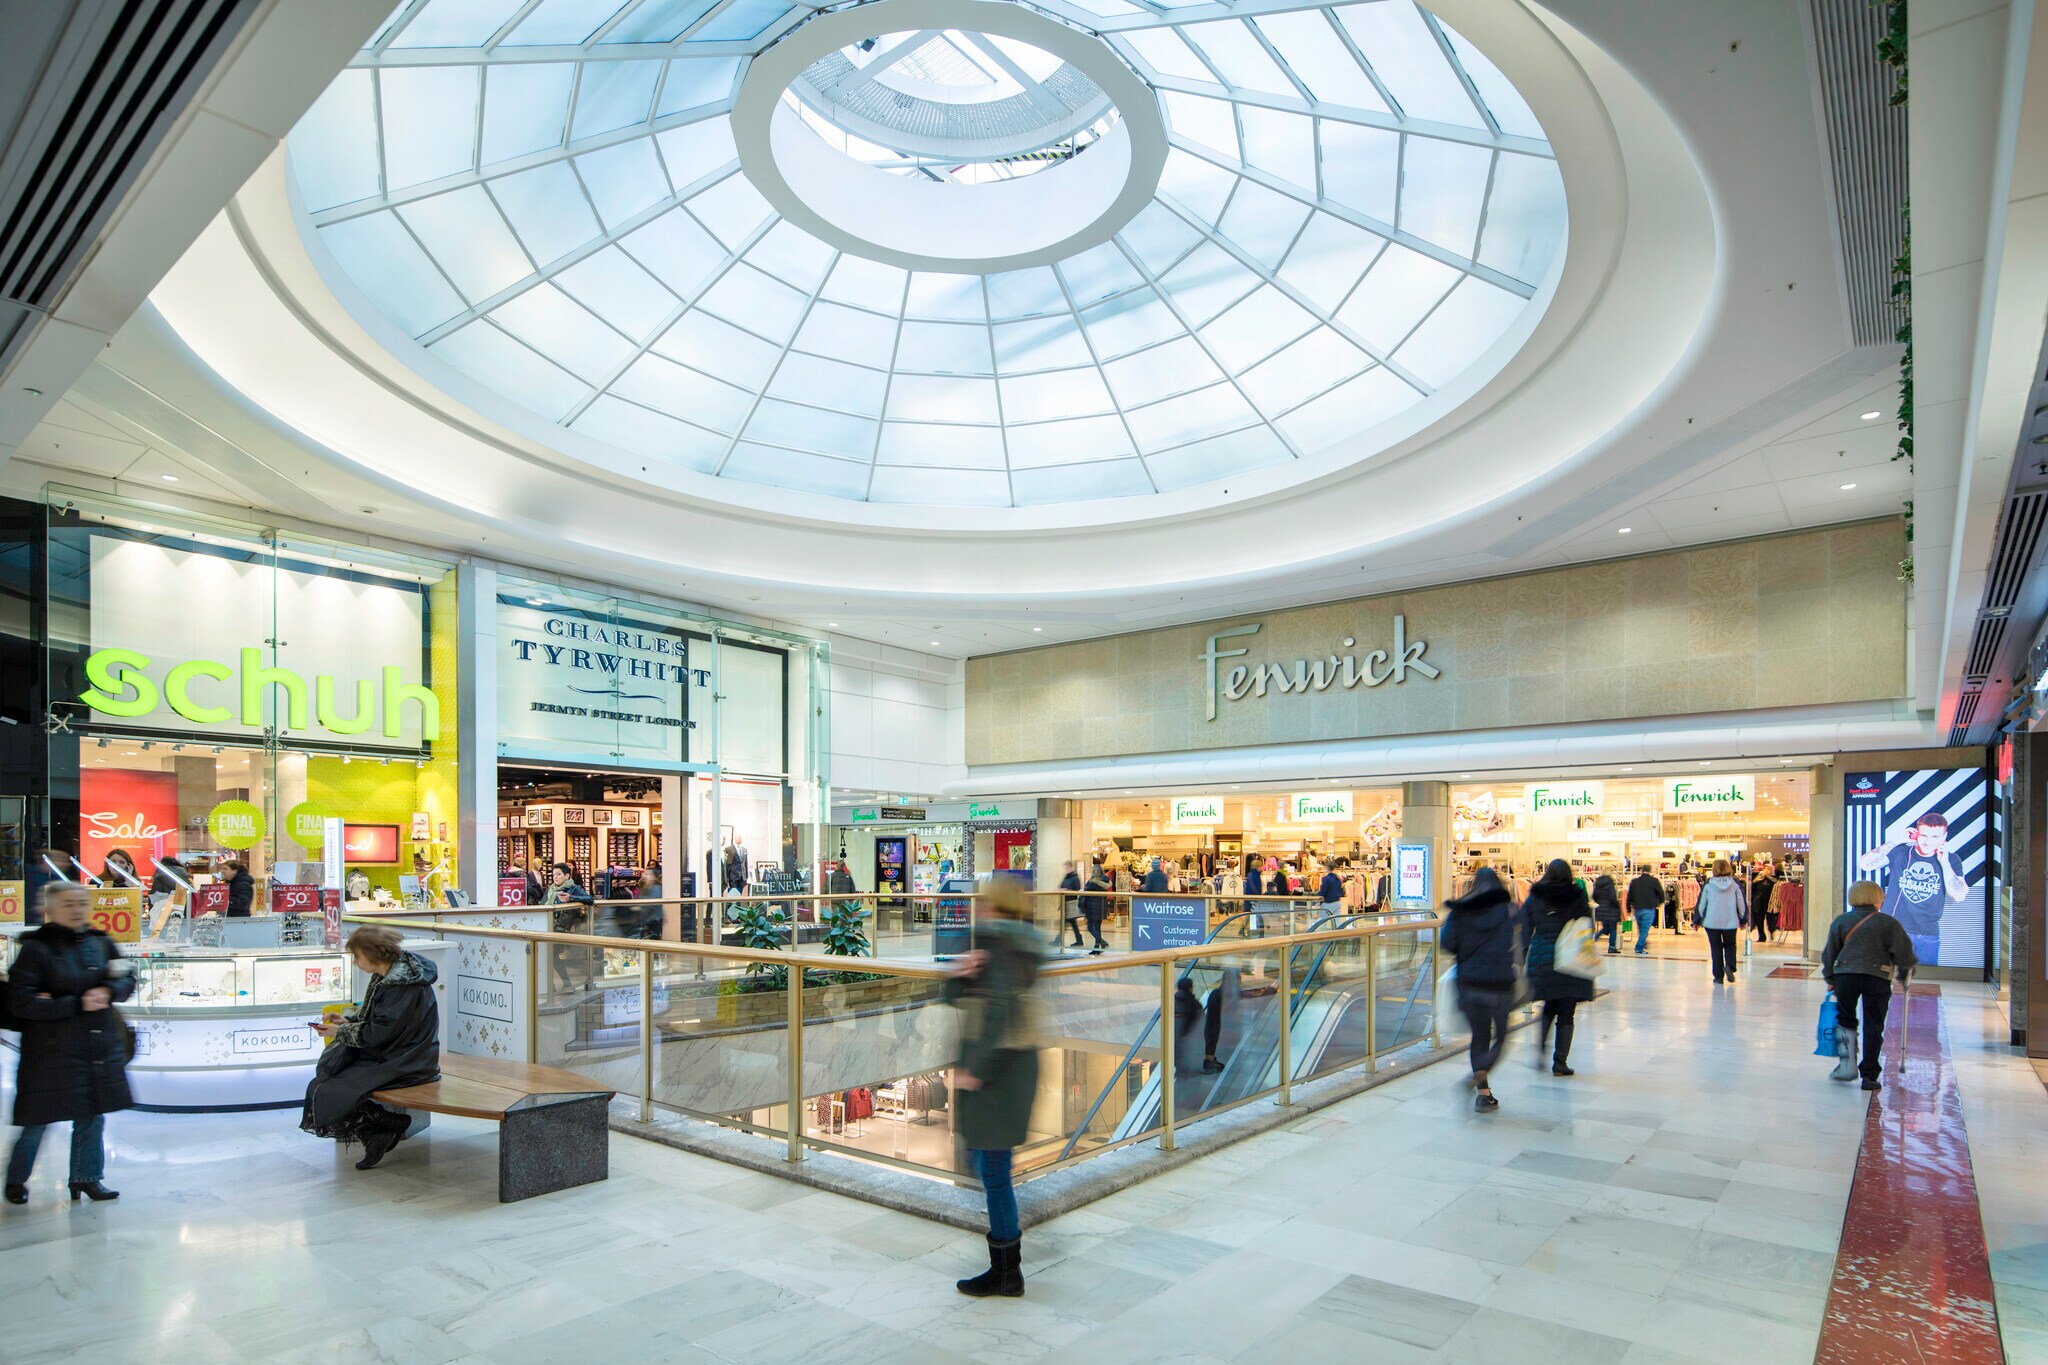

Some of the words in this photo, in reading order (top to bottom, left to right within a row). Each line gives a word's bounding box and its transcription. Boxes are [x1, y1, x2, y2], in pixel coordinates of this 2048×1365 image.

[544, 618, 686, 657] CHARLES
[511, 639, 711, 688] TYRWHITT
[1198, 614, 1440, 722] Fenwick
[78, 647, 440, 741] schuh
[530, 701, 588, 717] JERMYN
[591, 709, 643, 723] STREET
[645, 716, 697, 730] LONDON
[1533, 789, 1594, 811] Fenwick
[1673, 783, 1744, 807] Fenwick
[1176, 803, 1217, 821] Fenwick
[1298, 798, 1345, 817] Fenwick
[80, 812, 177, 839] Sale
[219, 814, 256, 829] FINAL
[219, 829, 256, 837] REDUCTIONS
[778, 881, 801, 892] NEW
[1143, 902, 1194, 915] Waitrose
[1163, 926, 1199, 935] Customer
[1163, 938, 1197, 946] entrance
[463, 988, 507, 1008] KOKOMO.
[242, 1034, 304, 1046] KOKOMO.
